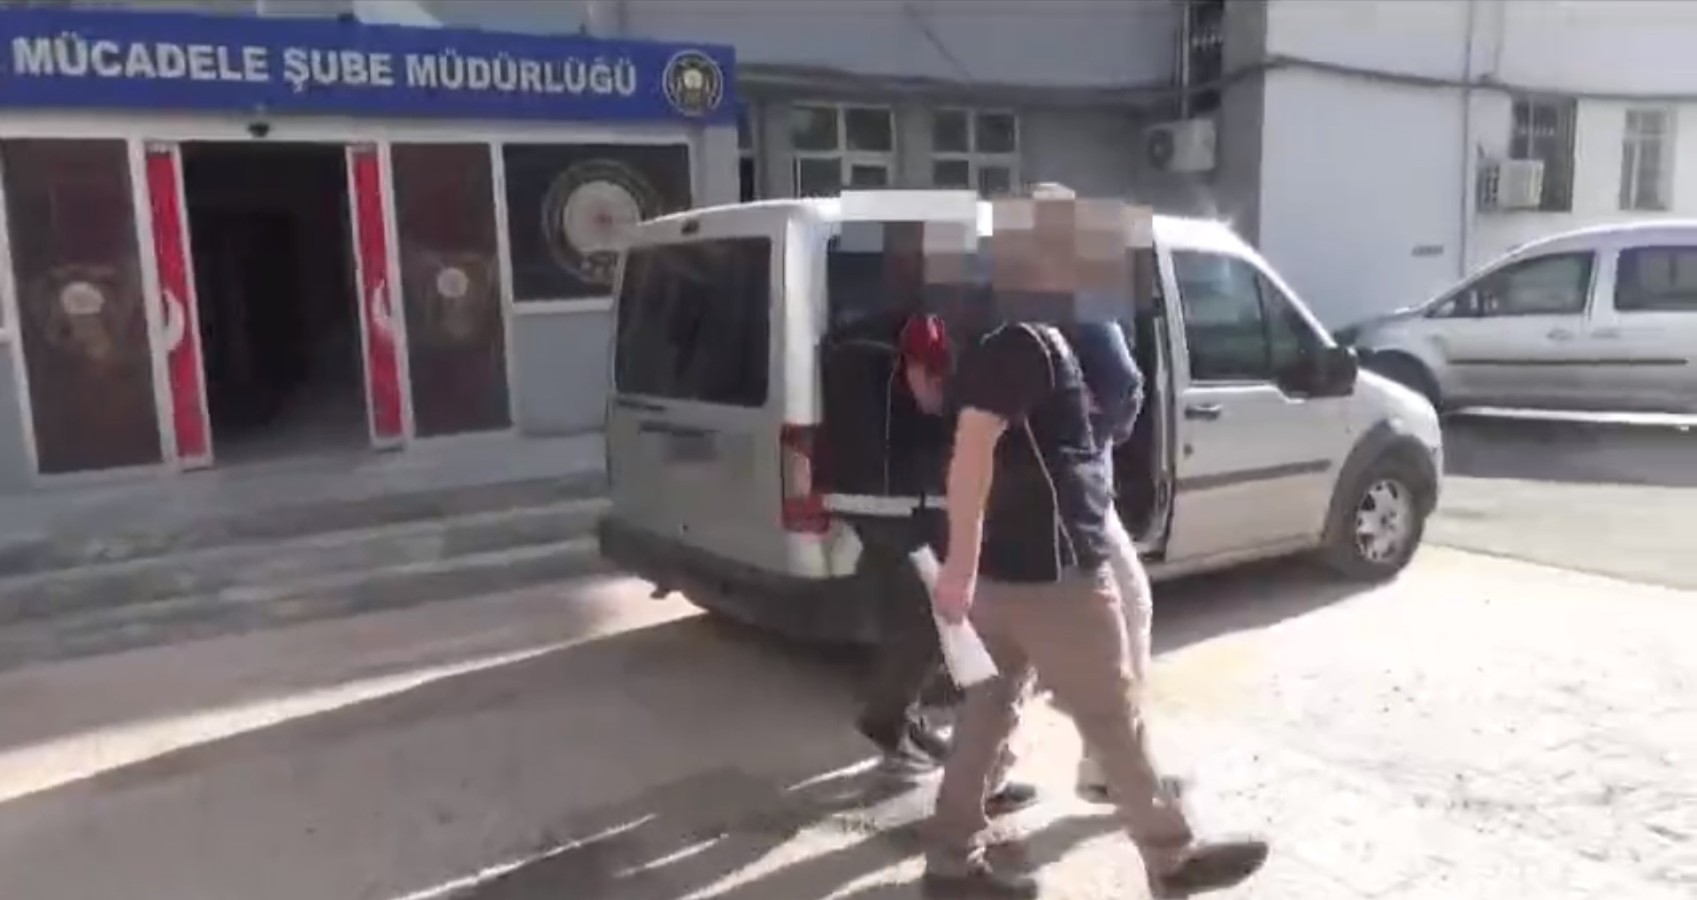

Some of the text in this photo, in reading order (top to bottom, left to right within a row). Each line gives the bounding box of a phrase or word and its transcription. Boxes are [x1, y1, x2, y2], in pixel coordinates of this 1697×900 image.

[12, 31, 269, 81] MÜCADELE
[283, 46, 395, 93] ŞUBE
[405, 48, 637, 96] MÜDÜRLÜĞÜ
